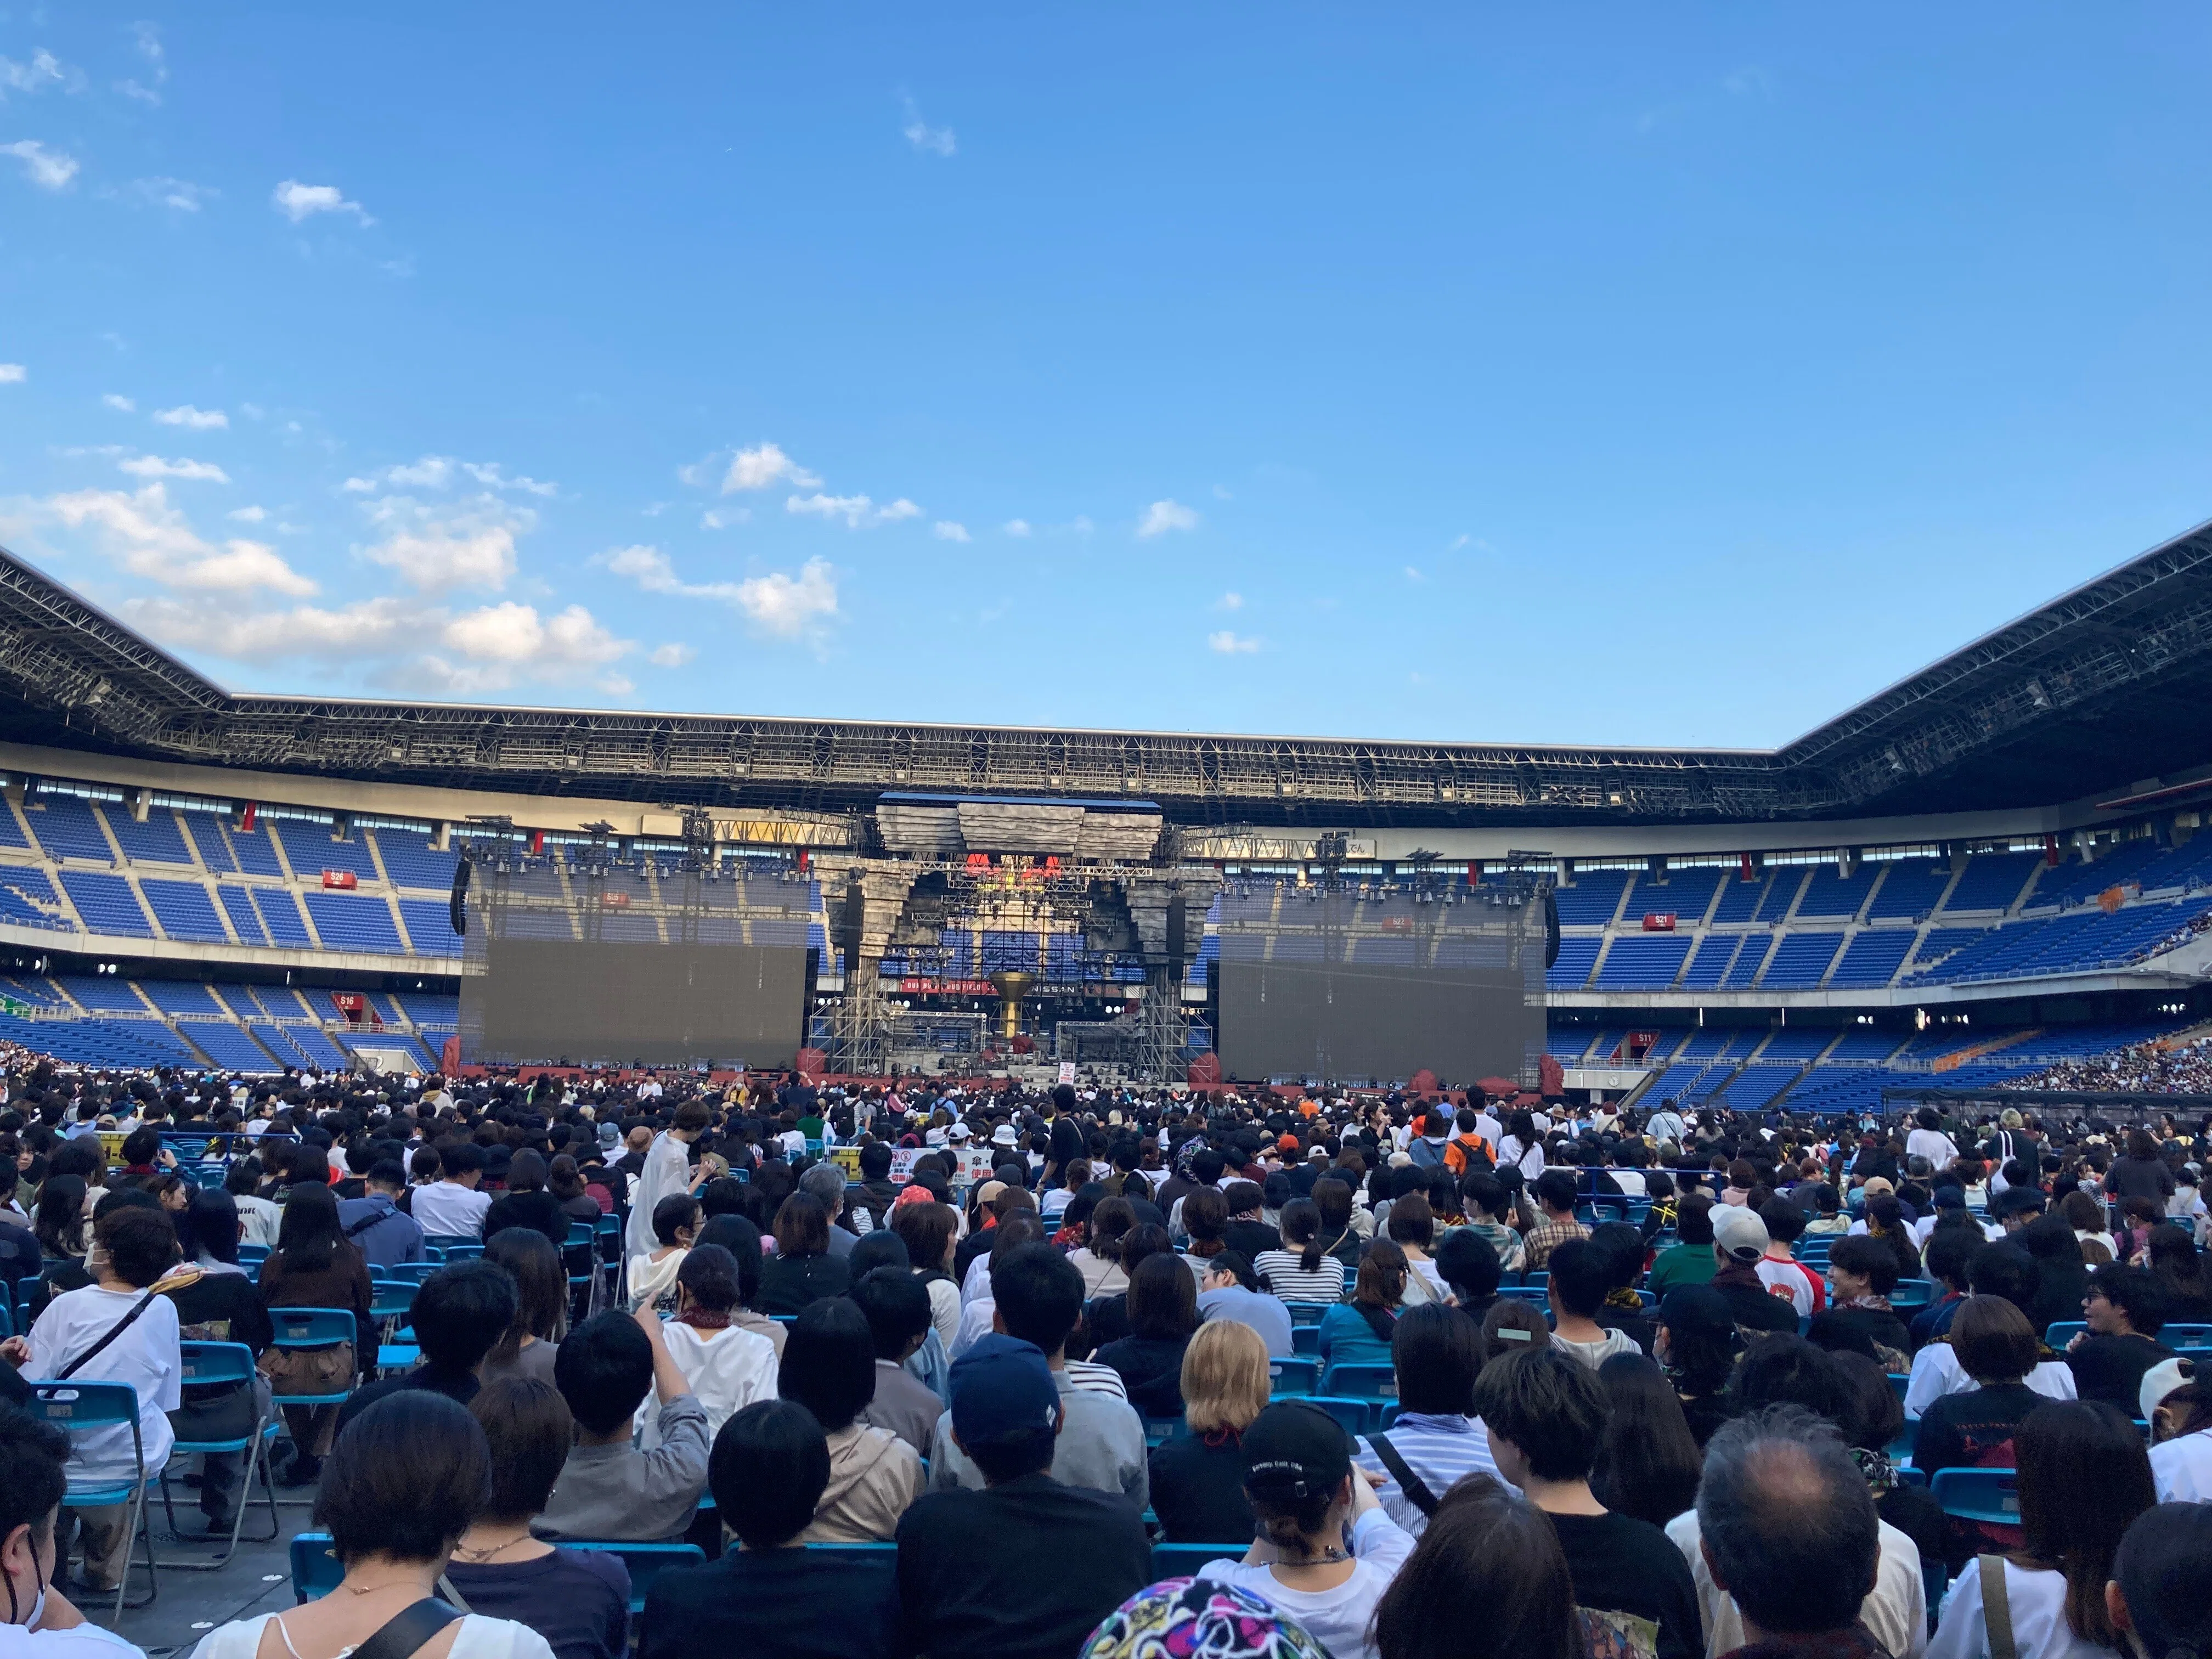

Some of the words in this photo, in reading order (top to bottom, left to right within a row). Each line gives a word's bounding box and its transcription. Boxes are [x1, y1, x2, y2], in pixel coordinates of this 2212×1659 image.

[330, 872, 344, 881] S26
[1655, 915, 1667, 923] S21
[340, 996, 354, 1005] S16
[1639, 1034, 1651, 1042] S11
[374, 1056, 383, 1072] 2
[1578, 1072, 1584, 1087] 1
[972, 1169, 995, 1179] 使用
